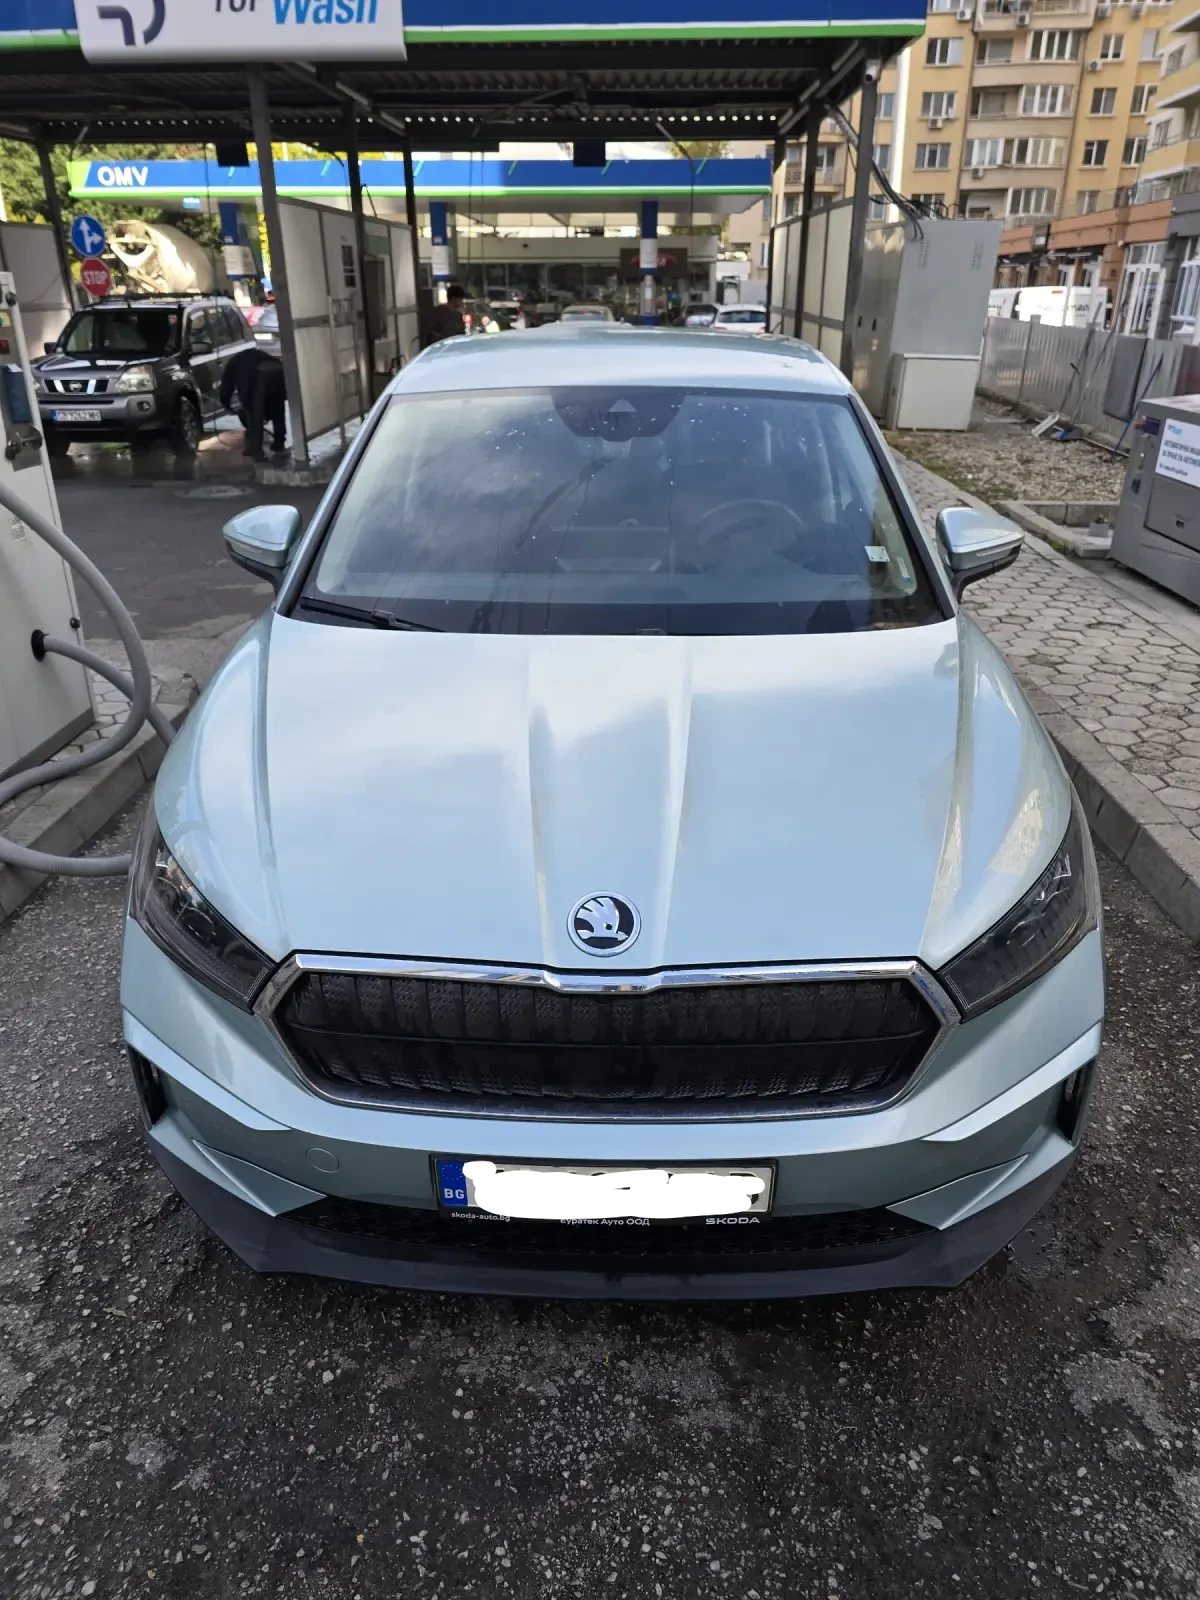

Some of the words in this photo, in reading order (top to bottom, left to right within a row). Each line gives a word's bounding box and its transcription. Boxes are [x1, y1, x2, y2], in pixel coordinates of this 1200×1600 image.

[97, 166, 148, 186] OMV
[83, 270, 107, 285] STOP
[444, 1188, 465, 1199] BG
[451, 1212, 511, 1222] skoda-auto.bg
[600, 1218, 624, 1226] Ауто
[626, 1218, 650, 1226] ООД
